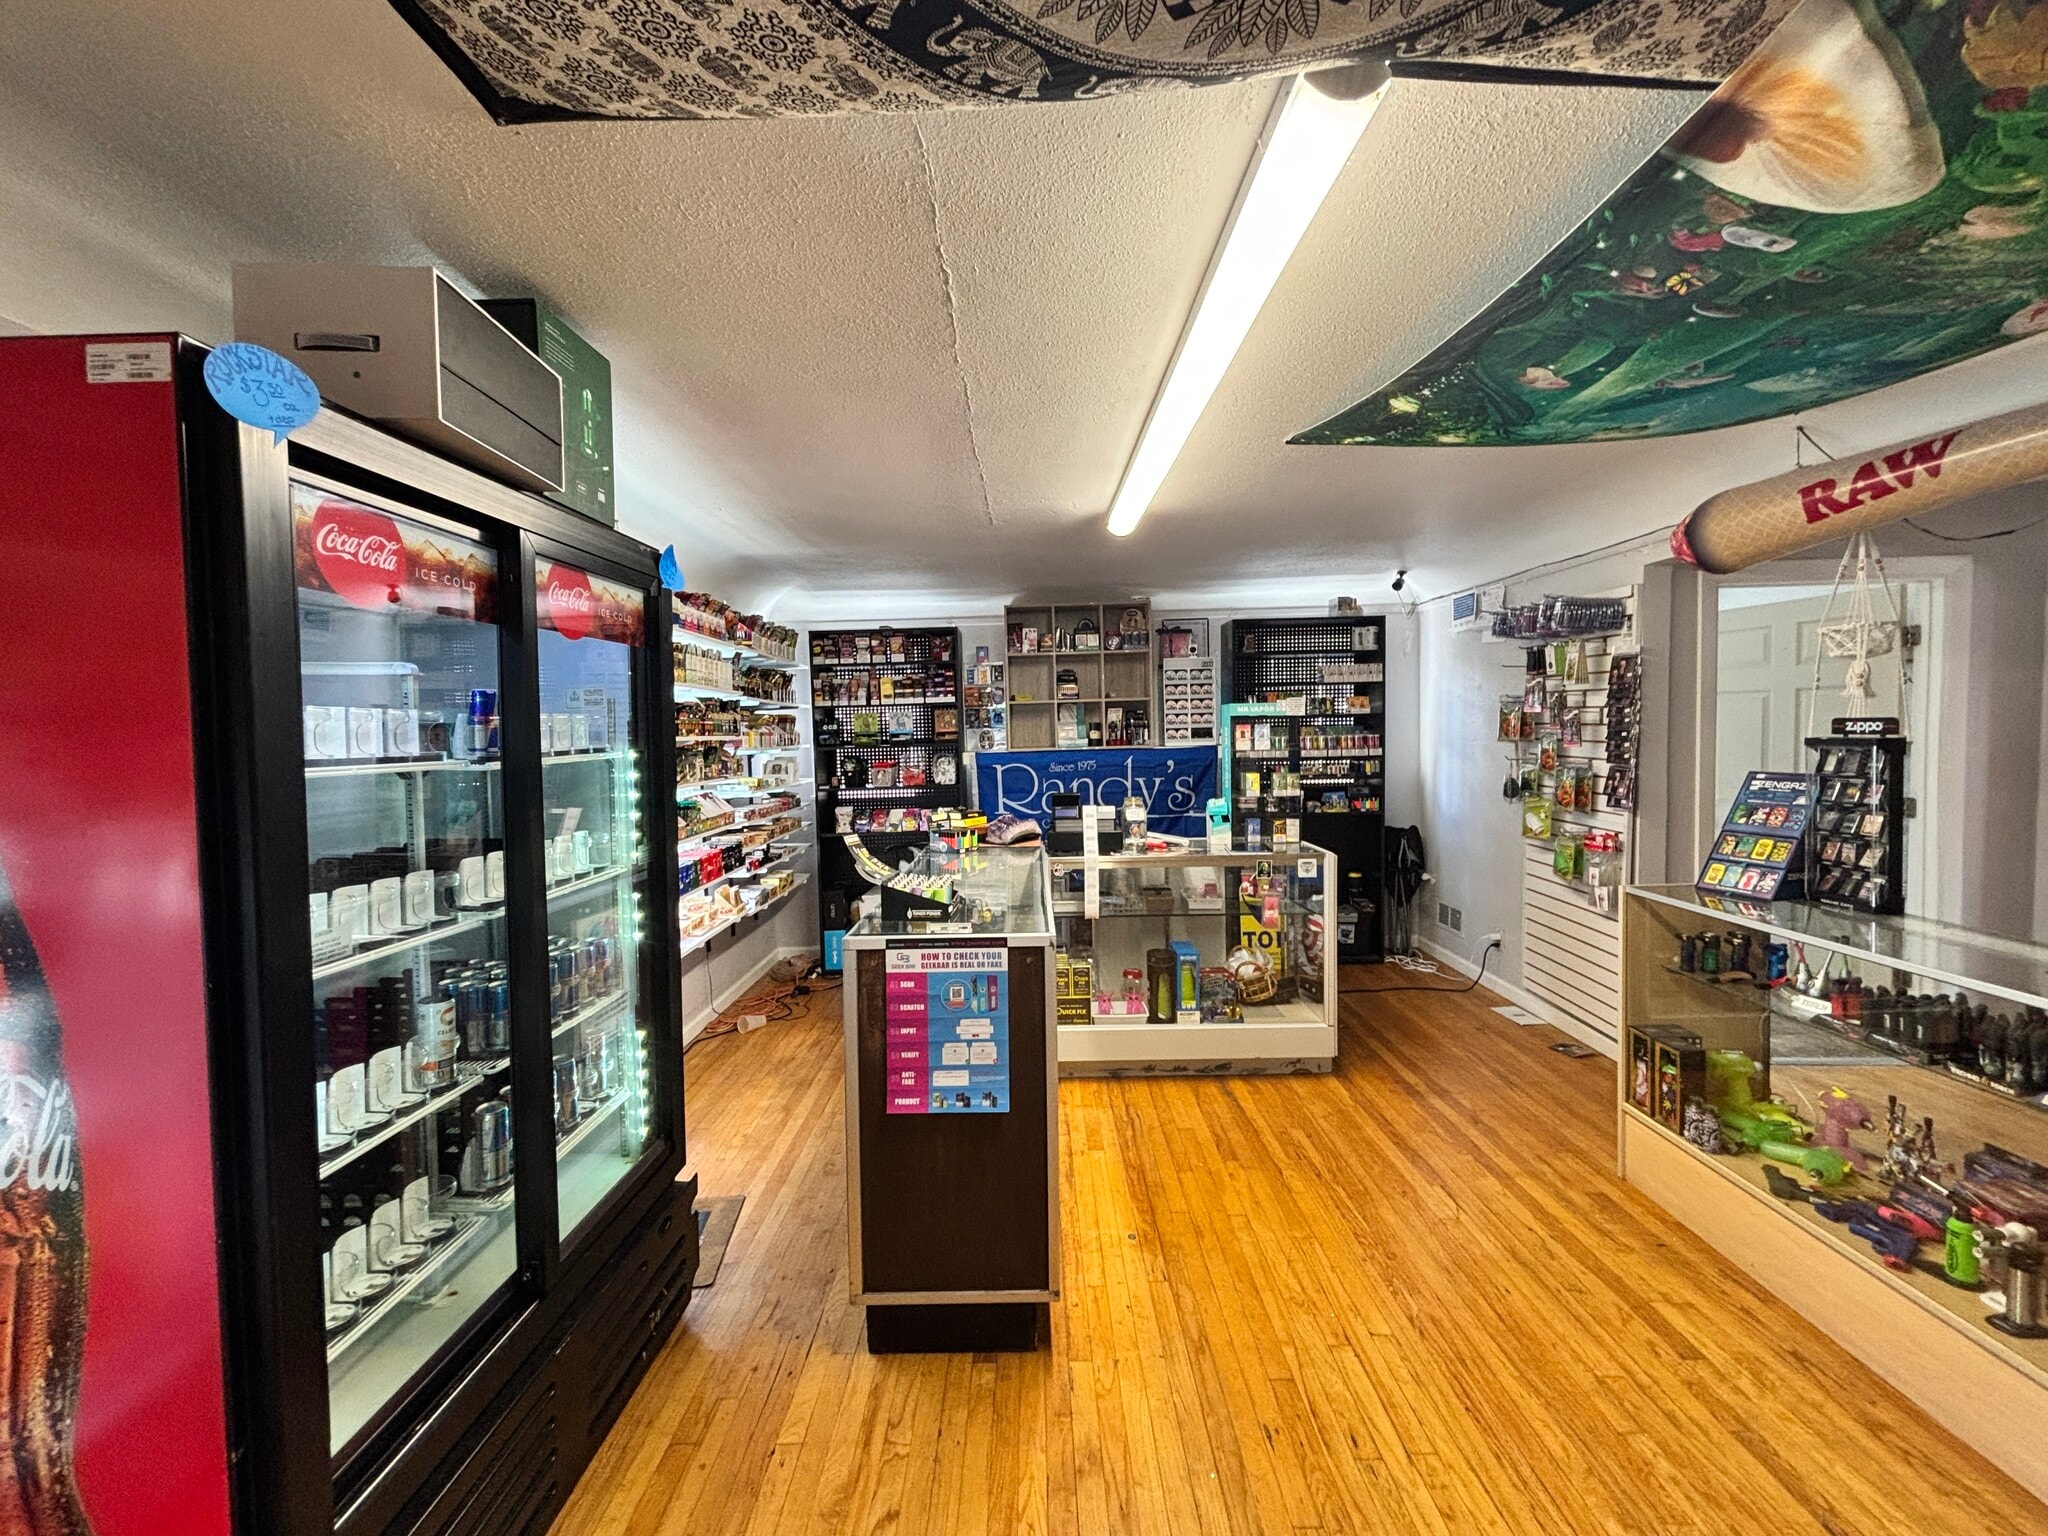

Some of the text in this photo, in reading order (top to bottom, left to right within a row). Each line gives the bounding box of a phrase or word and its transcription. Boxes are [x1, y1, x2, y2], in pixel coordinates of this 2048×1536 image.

[1797, 430, 1964, 524] RAW
[316, 523, 402, 571] Coca-Cola
[415, 567, 476, 591] ICE COLD
[549, 581, 590, 612] Coca-Cola
[598, 608, 632, 623] ICE COLD
[1049, 759, 1097, 772] Since 1975
[1750, 780, 1808, 790] ZENGAZ
[921, 951, 1002, 961] HOW TO CHECK YOUR
[921, 961, 950, 969] GEEKBAR
[951, 961, 958, 969] IS
[987, 960, 1002, 968] FAKE
[895, 1097, 920, 1105] PRODUCT
